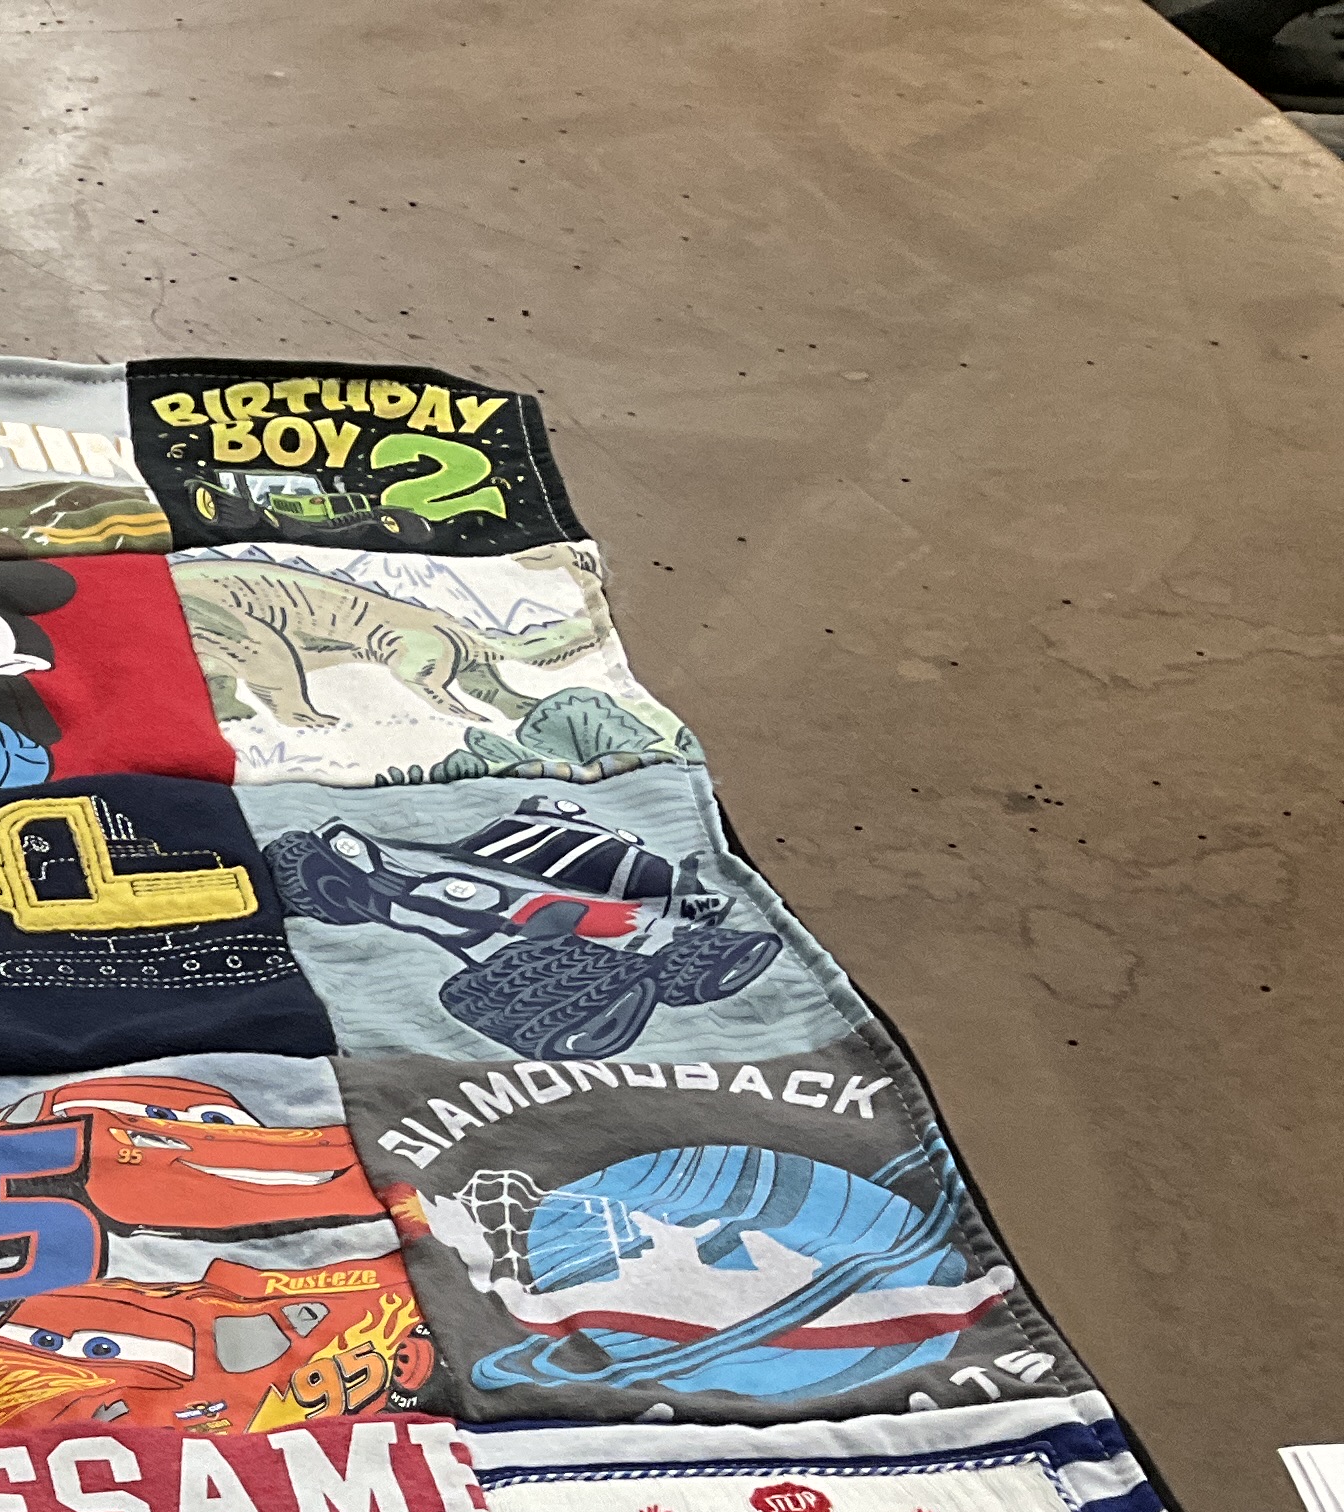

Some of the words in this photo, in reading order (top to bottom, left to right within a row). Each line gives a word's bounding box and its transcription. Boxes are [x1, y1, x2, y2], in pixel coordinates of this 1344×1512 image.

[151, 377, 510, 435] BIRTHDAY
[210, 416, 362, 468] BOY
[370, 433, 508, 522] 2
[377, 1060, 894, 1170] DIAMONDBACK
[117, 1147, 143, 1166] 95
[290, 1340, 390, 1420] 95
